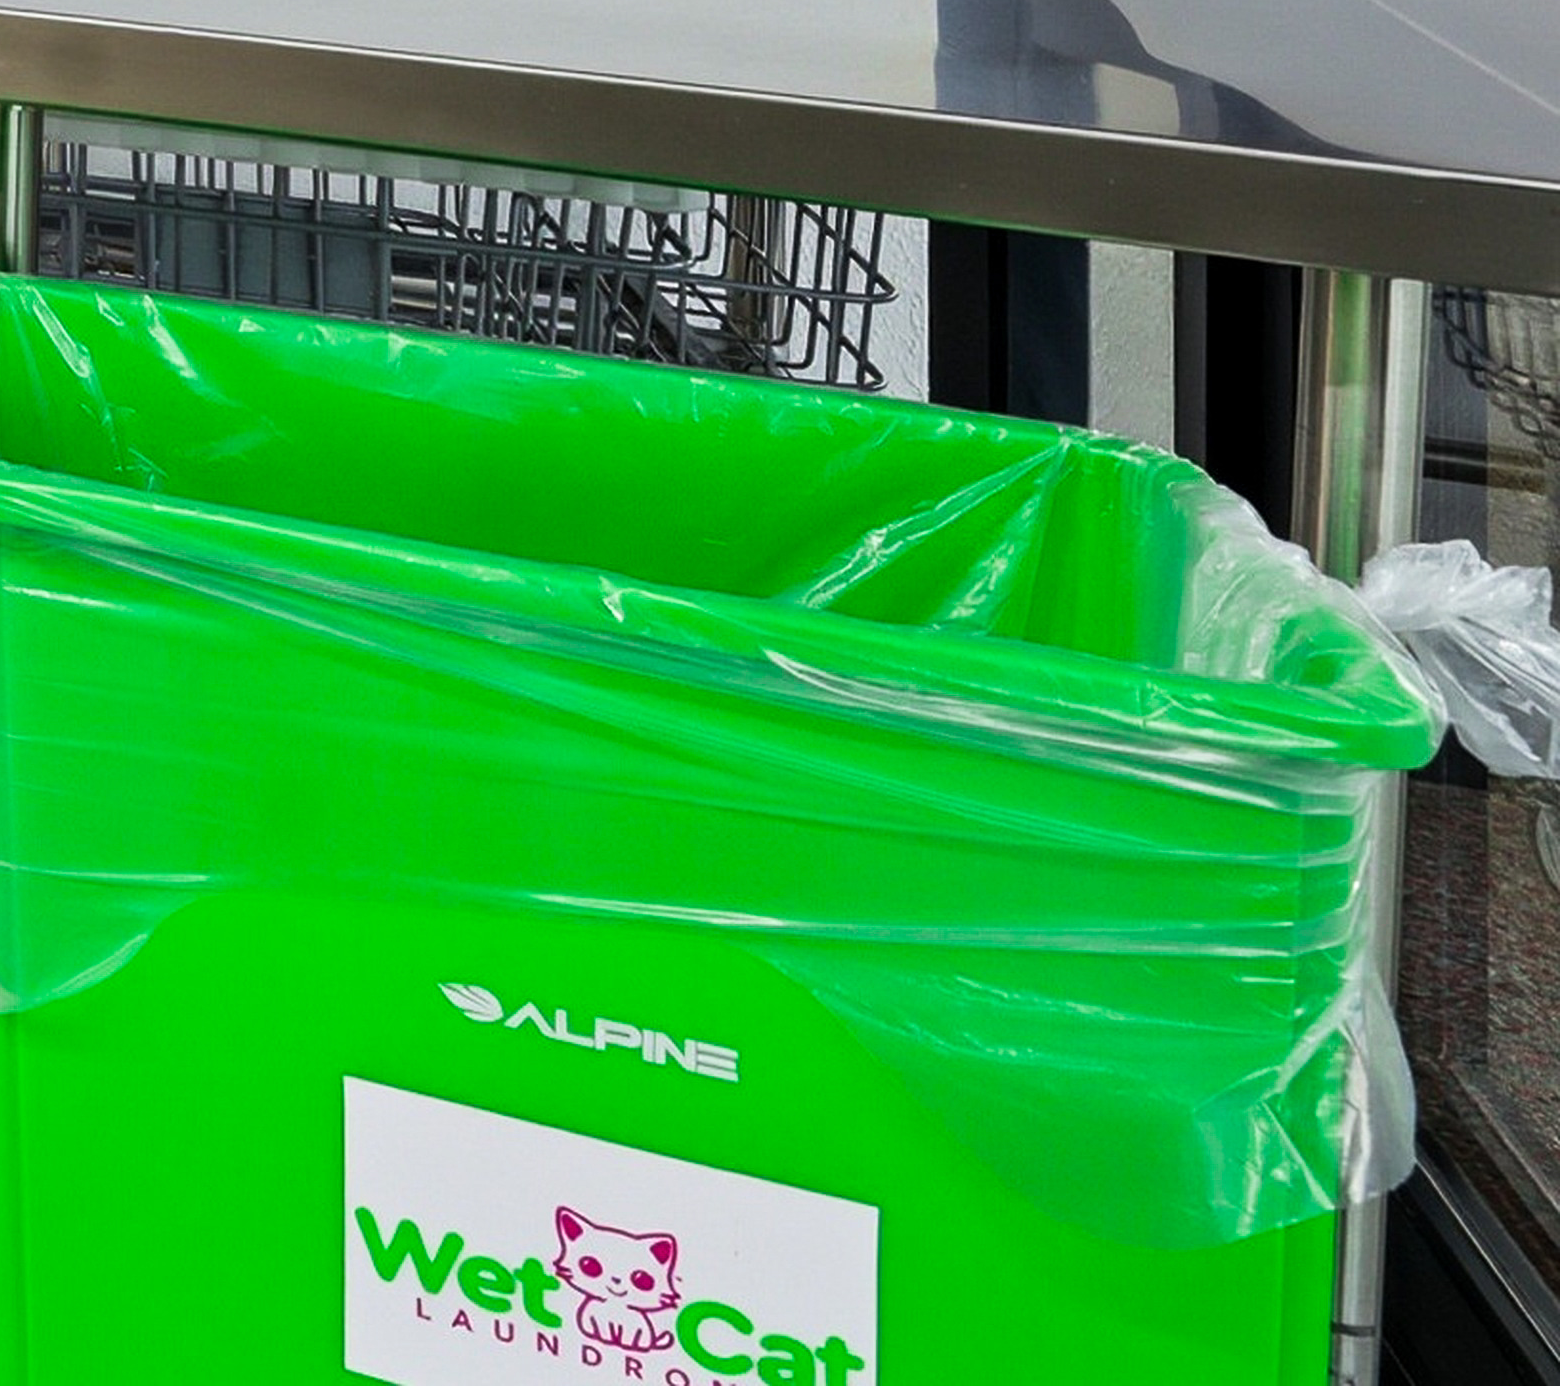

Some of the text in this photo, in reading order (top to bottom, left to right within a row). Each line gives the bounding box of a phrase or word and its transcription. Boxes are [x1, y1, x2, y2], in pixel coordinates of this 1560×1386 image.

[503, 1001, 739, 1083] ALPINE
[354, 1206, 865, 1386] Wet Cat
